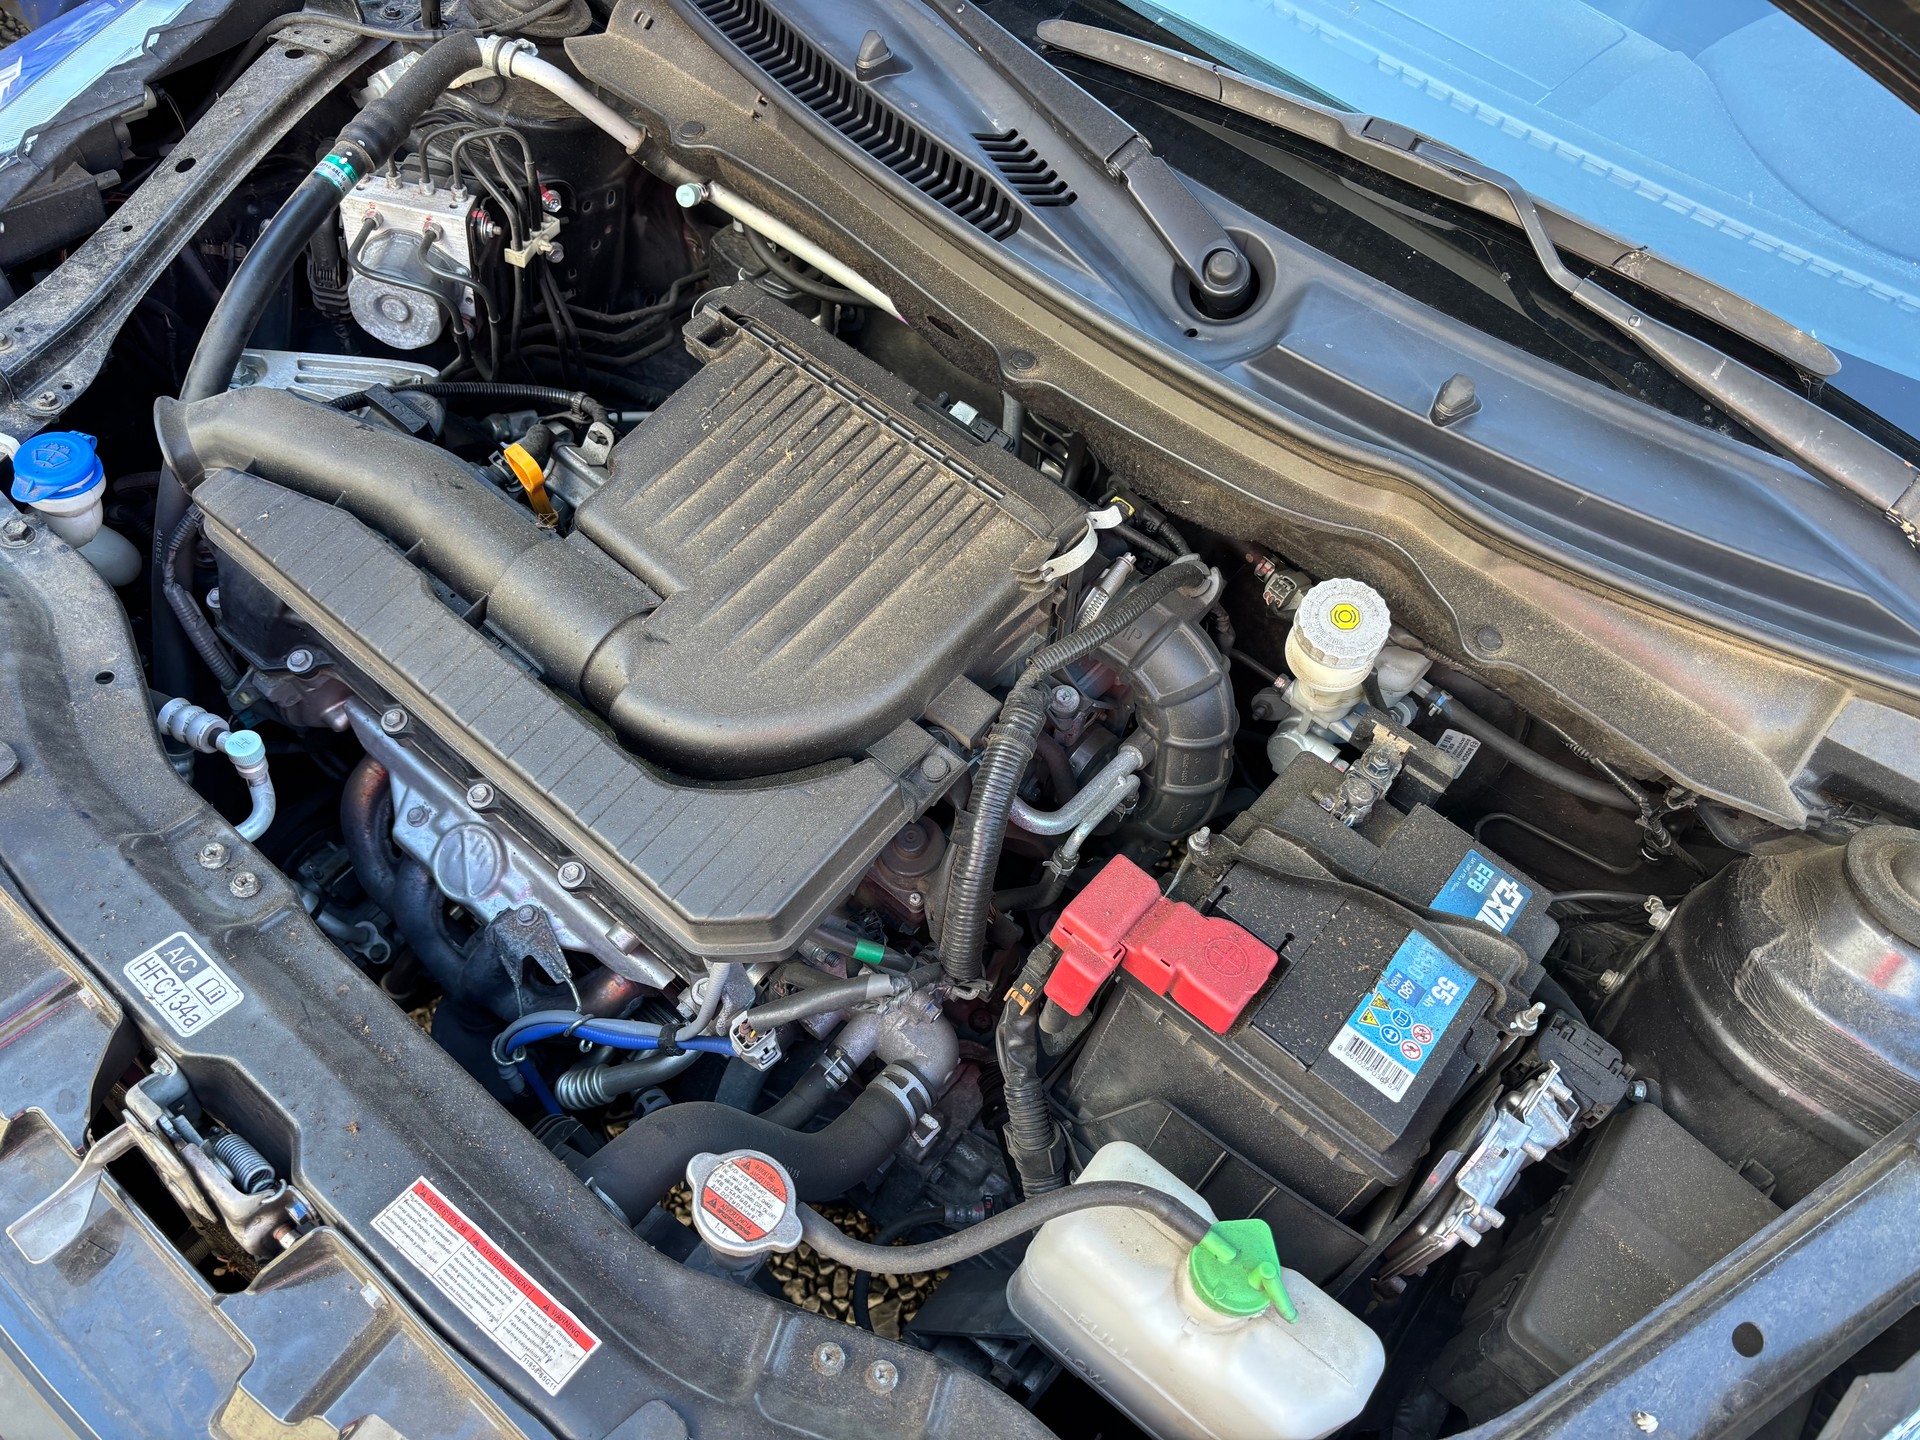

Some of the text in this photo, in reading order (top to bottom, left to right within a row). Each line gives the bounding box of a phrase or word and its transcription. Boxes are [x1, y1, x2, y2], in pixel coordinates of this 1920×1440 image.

[419, 397, 434, 412] OIL
[1461, 747, 1473, 762] BOSCH
[1465, 861, 1495, 894] EFB
[163, 946, 198, 974] A/C
[134, 956, 201, 1028] HFC134a
[1395, 977, 1417, 1000] 480
[1421, 973, 1461, 1009] 55 Ah
[426, 1194, 468, 1234] ADVERTENCIA
[713, 1221, 727, 1234] 1.1
[480, 1244, 531, 1292] AVERTISSEMENT
[550, 1308, 581, 1338] WARNING
[1077, 1313, 1132, 1364] FULL
[1063, 1347, 1106, 1384] LOW
